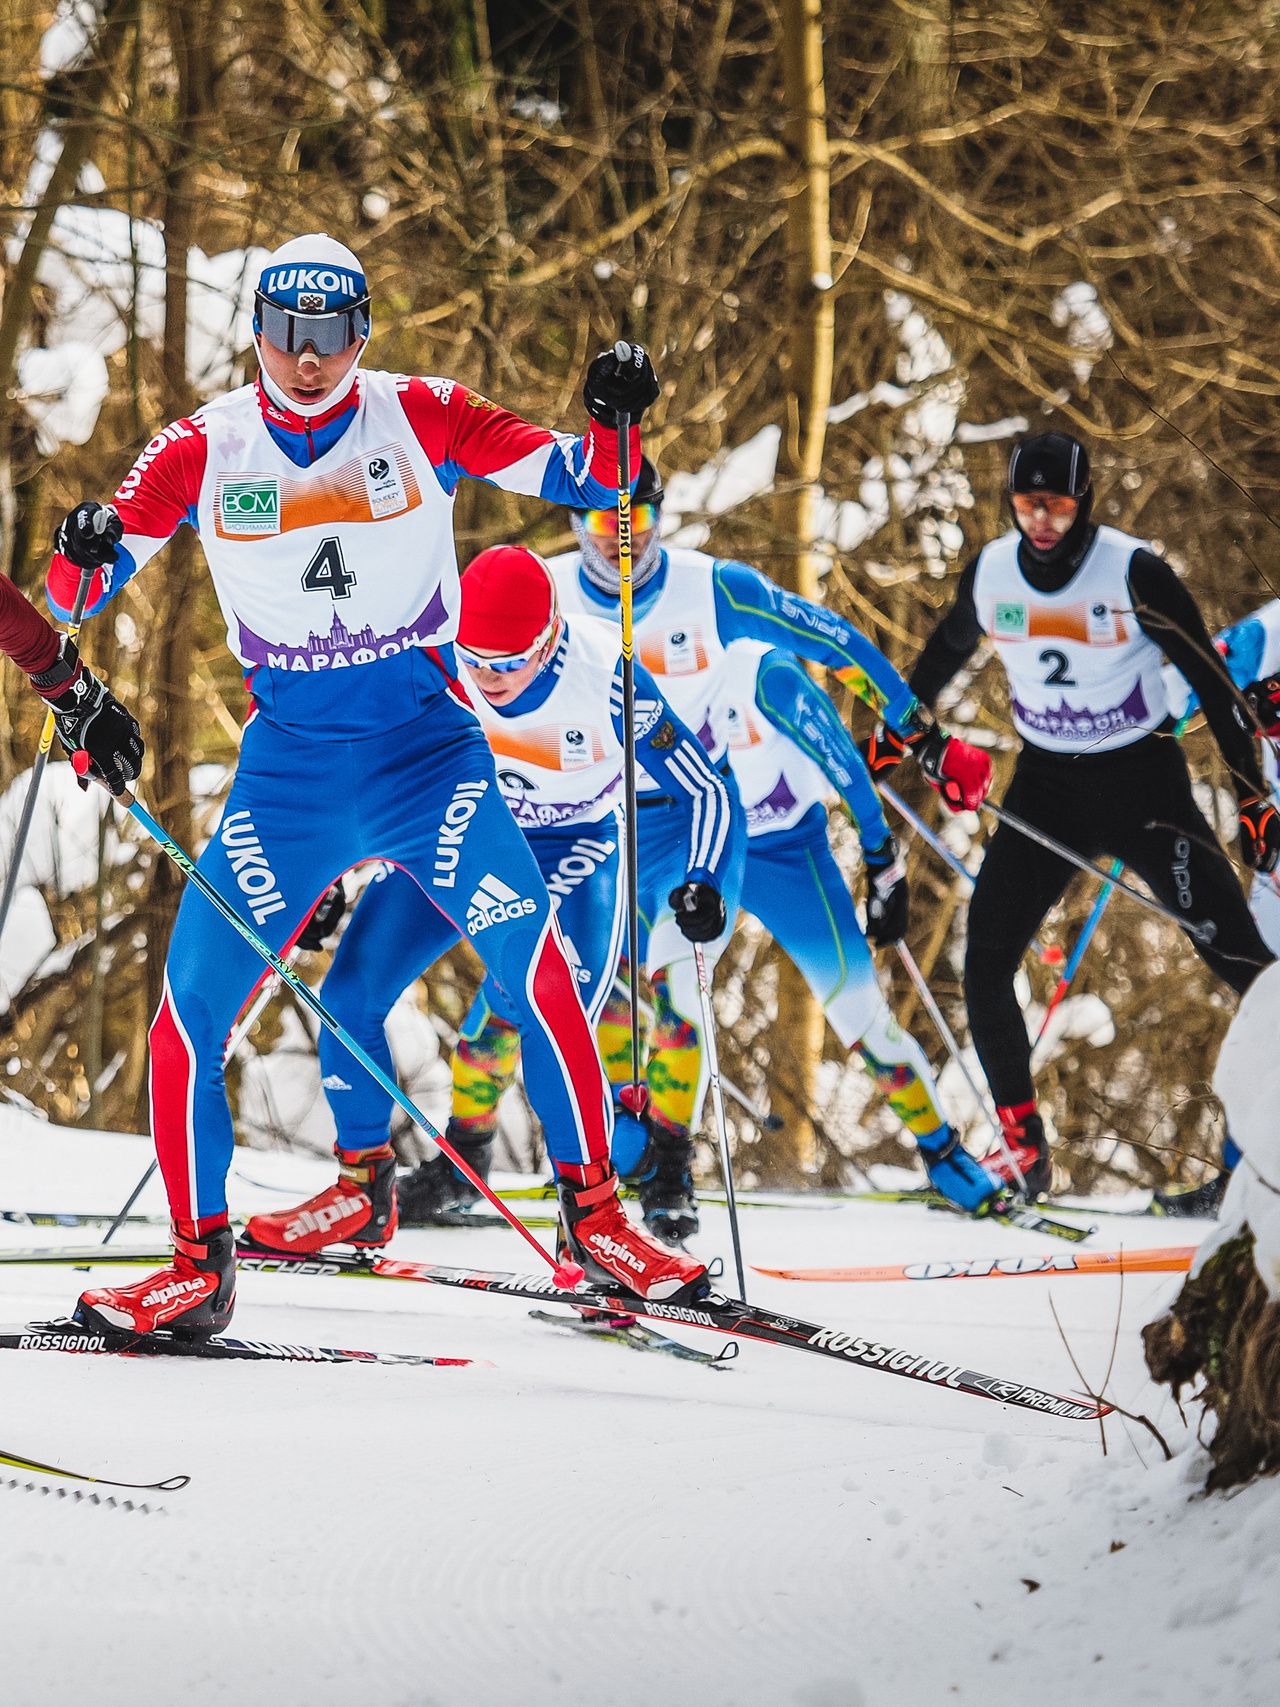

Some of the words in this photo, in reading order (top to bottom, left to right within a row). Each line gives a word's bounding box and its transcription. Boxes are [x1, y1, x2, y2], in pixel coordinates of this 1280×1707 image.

[268, 269, 357, 299] LUKOIL
[115, 421, 194, 500] LUKOIL
[301, 536, 357, 600] 4
[267, 631, 421, 672] МАРАФОН
[1039, 650, 1077, 686] 2
[433, 779, 489, 888] LUKOIL
[221, 810, 287, 926] LUKOIL
[1172, 837, 1193, 909] odlo
[467, 898, 537, 937] adidas
[282, 1192, 373, 1243] alpin
[589, 1232, 646, 1274] alpina
[902, 1254, 1078, 1280] YOKO
[141, 1277, 207, 1308] alpina
[643, 1301, 718, 1328] ROSSIGNOL
[19, 1334, 107, 1351] ROSSIGNOL
[807, 1327, 968, 1388] ROSSIGNOL
[1016, 1389, 1092, 1419] PREMIUM
